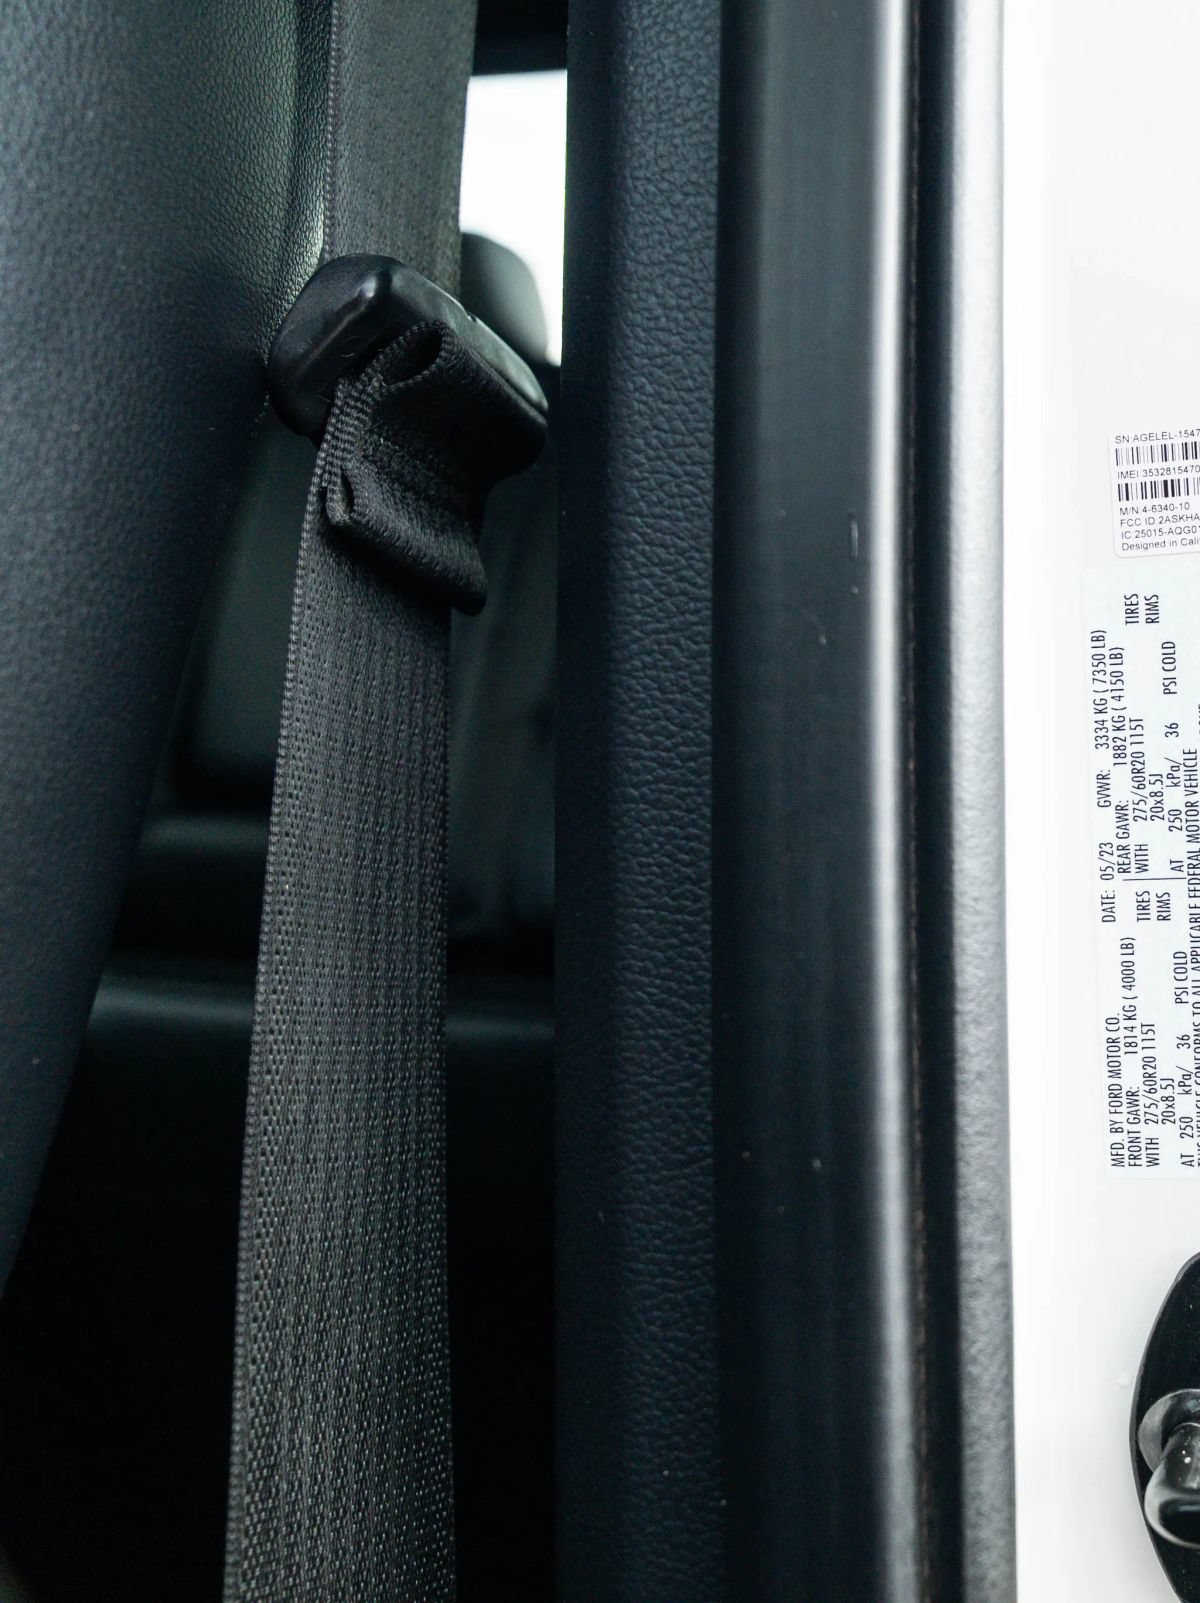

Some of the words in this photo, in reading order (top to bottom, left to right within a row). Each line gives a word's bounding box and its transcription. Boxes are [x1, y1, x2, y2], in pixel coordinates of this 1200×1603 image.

[1120, 518, 1142, 528] FCC
[1121, 541, 1166, 552] Designed
[1169, 540, 1178, 548] in
[1123, 593, 1140, 626] TIRES
[1144, 594, 1160, 624] RIMS
[1090, 630, 1107, 649] LB)
[1091, 653, 1107, 685] 7350
[1108, 647, 1125, 666] LB)
[1161, 641, 1177, 672] COLD
[1109, 670, 1125, 702] 4150
[1162, 677, 1178, 695] PSI
[1092, 698, 1108, 715] KG
[1094, 719, 1110, 750] 3334
[1111, 715, 1126, 732] KG
[1129, 717, 1144, 746] 115T
[1164, 722, 1179, 738] 36
[1111, 736, 1127, 767] 1882
[1130, 751, 1149, 822] 275/60R20
[1164, 757, 1182, 788] kPa/
[1182, 748, 1199, 797] VEHICLE
[1096, 769, 1112, 808] GVWR:
[1148, 773, 1165, 821] 20x8.5J
[1114, 800, 1130, 840] GAWR:
[1167, 809, 1183, 832] 250
[1184, 800, 1200, 844] MOTOR
[1098, 842, 1116, 881] 05/23
[1116, 844, 1132, 874] REAR
[1134, 844, 1149, 874] WITH
[1169, 858, 1184, 873] AT
[1100, 890, 1116, 923] DATE:
[1135, 890, 1151, 923] TIRES
[1155, 892, 1171, 921] RIMS
[1120, 937, 1136, 956] LB)
[1120, 960, 1136, 991] 4000
[1173, 951, 1188, 982] COLD
[1174, 987, 1189, 1004] PSI
[1105, 1013, 1120, 1032] CO.
[1122, 1004, 1137, 1021] KG
[1123, 1025, 1138, 1055] 1814
[1140, 1022, 1156, 1051] 115T
[1176, 1034, 1191, 1049] 36
[1106, 1037, 1122, 1079] MOTOR
[1141, 1056, 1160, 1125] 275/60R20
[1176, 1065, 1194, 1095] kPa/
[1107, 1083, 1123, 1115] FORD
[1125, 1086, 1141, 1125] GAWR:
[1159, 1078, 1176, 1125] 20x8.5J
[1109, 1119, 1124, 1134] BY
[1179, 1116, 1194, 1139] 250
[1110, 1139, 1125, 1167] MFD.
[1127, 1129, 1143, 1167] FRONT
[1145, 1137, 1160, 1167] WITH
[1180, 1153, 1195, 1168] AT
